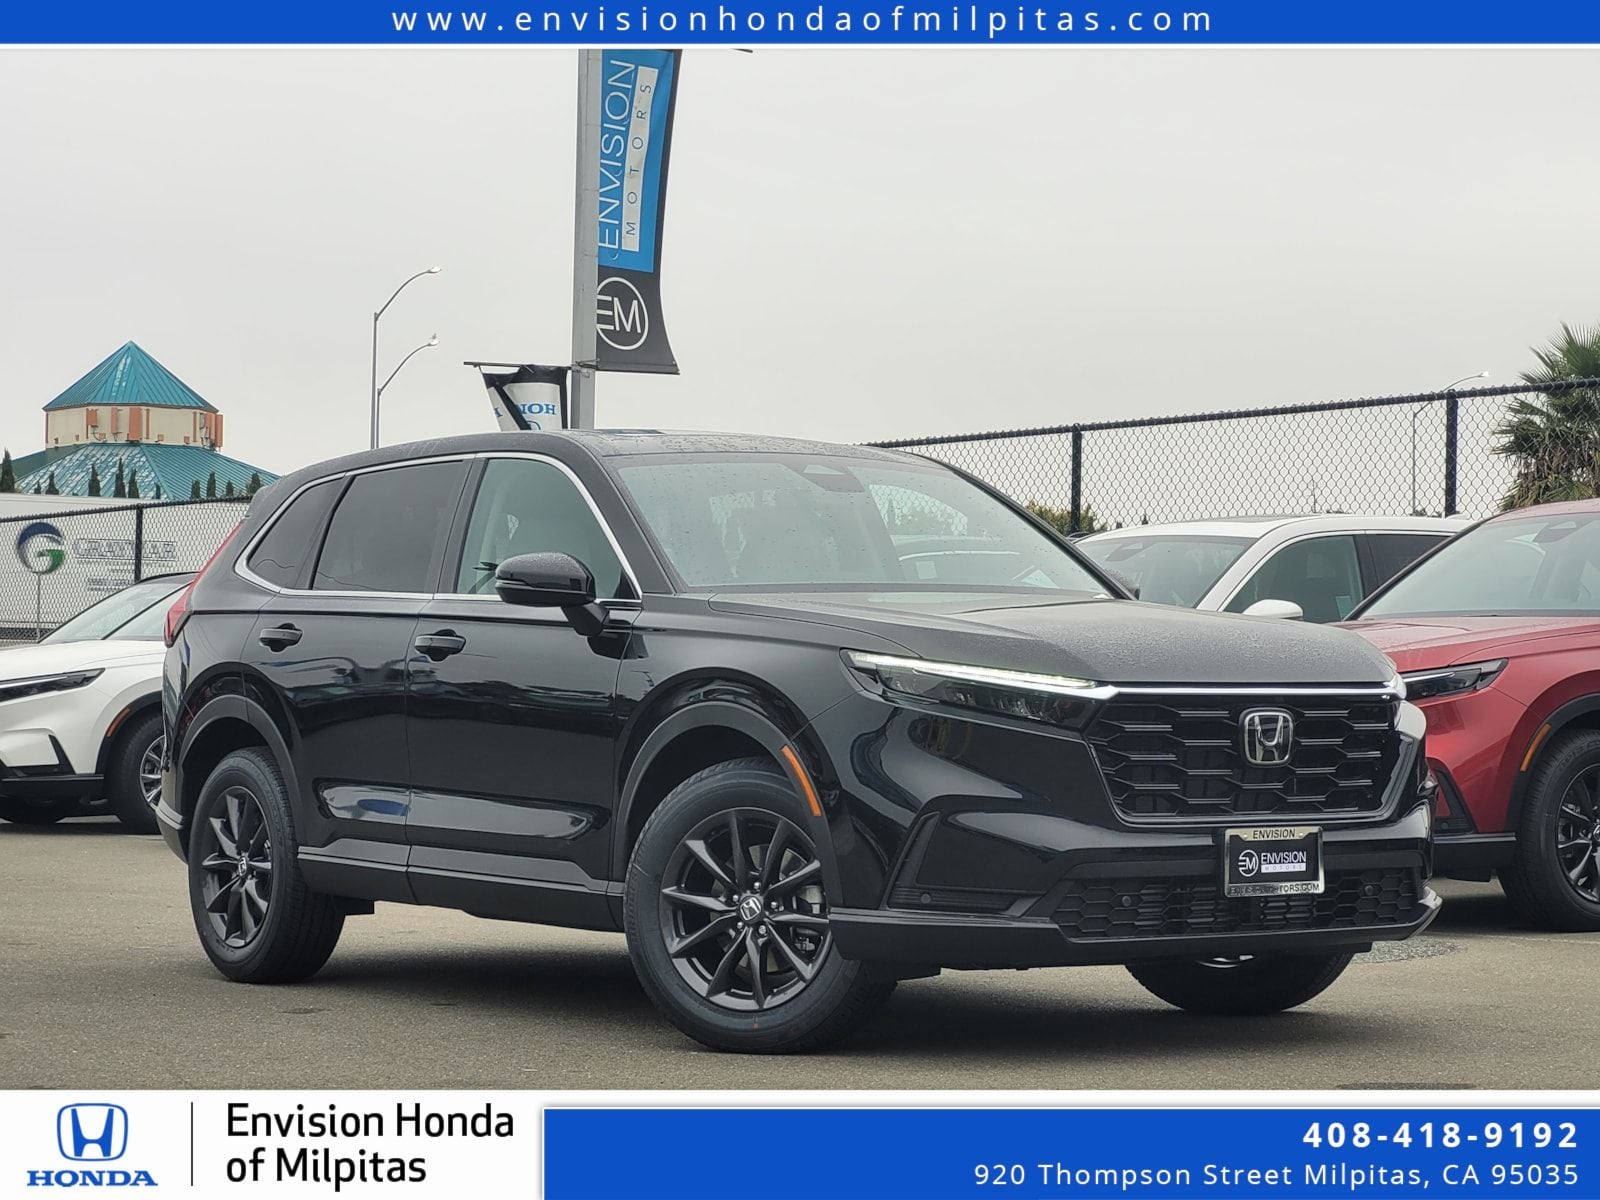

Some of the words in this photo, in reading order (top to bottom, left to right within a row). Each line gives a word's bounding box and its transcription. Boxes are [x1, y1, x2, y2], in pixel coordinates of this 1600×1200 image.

[598, 59, 636, 249] ENVISION
[626, 84, 652, 236] MOTORS
[1252, 829, 1296, 839] ENVISION
[1261, 851, 1307, 864] ENVISION
